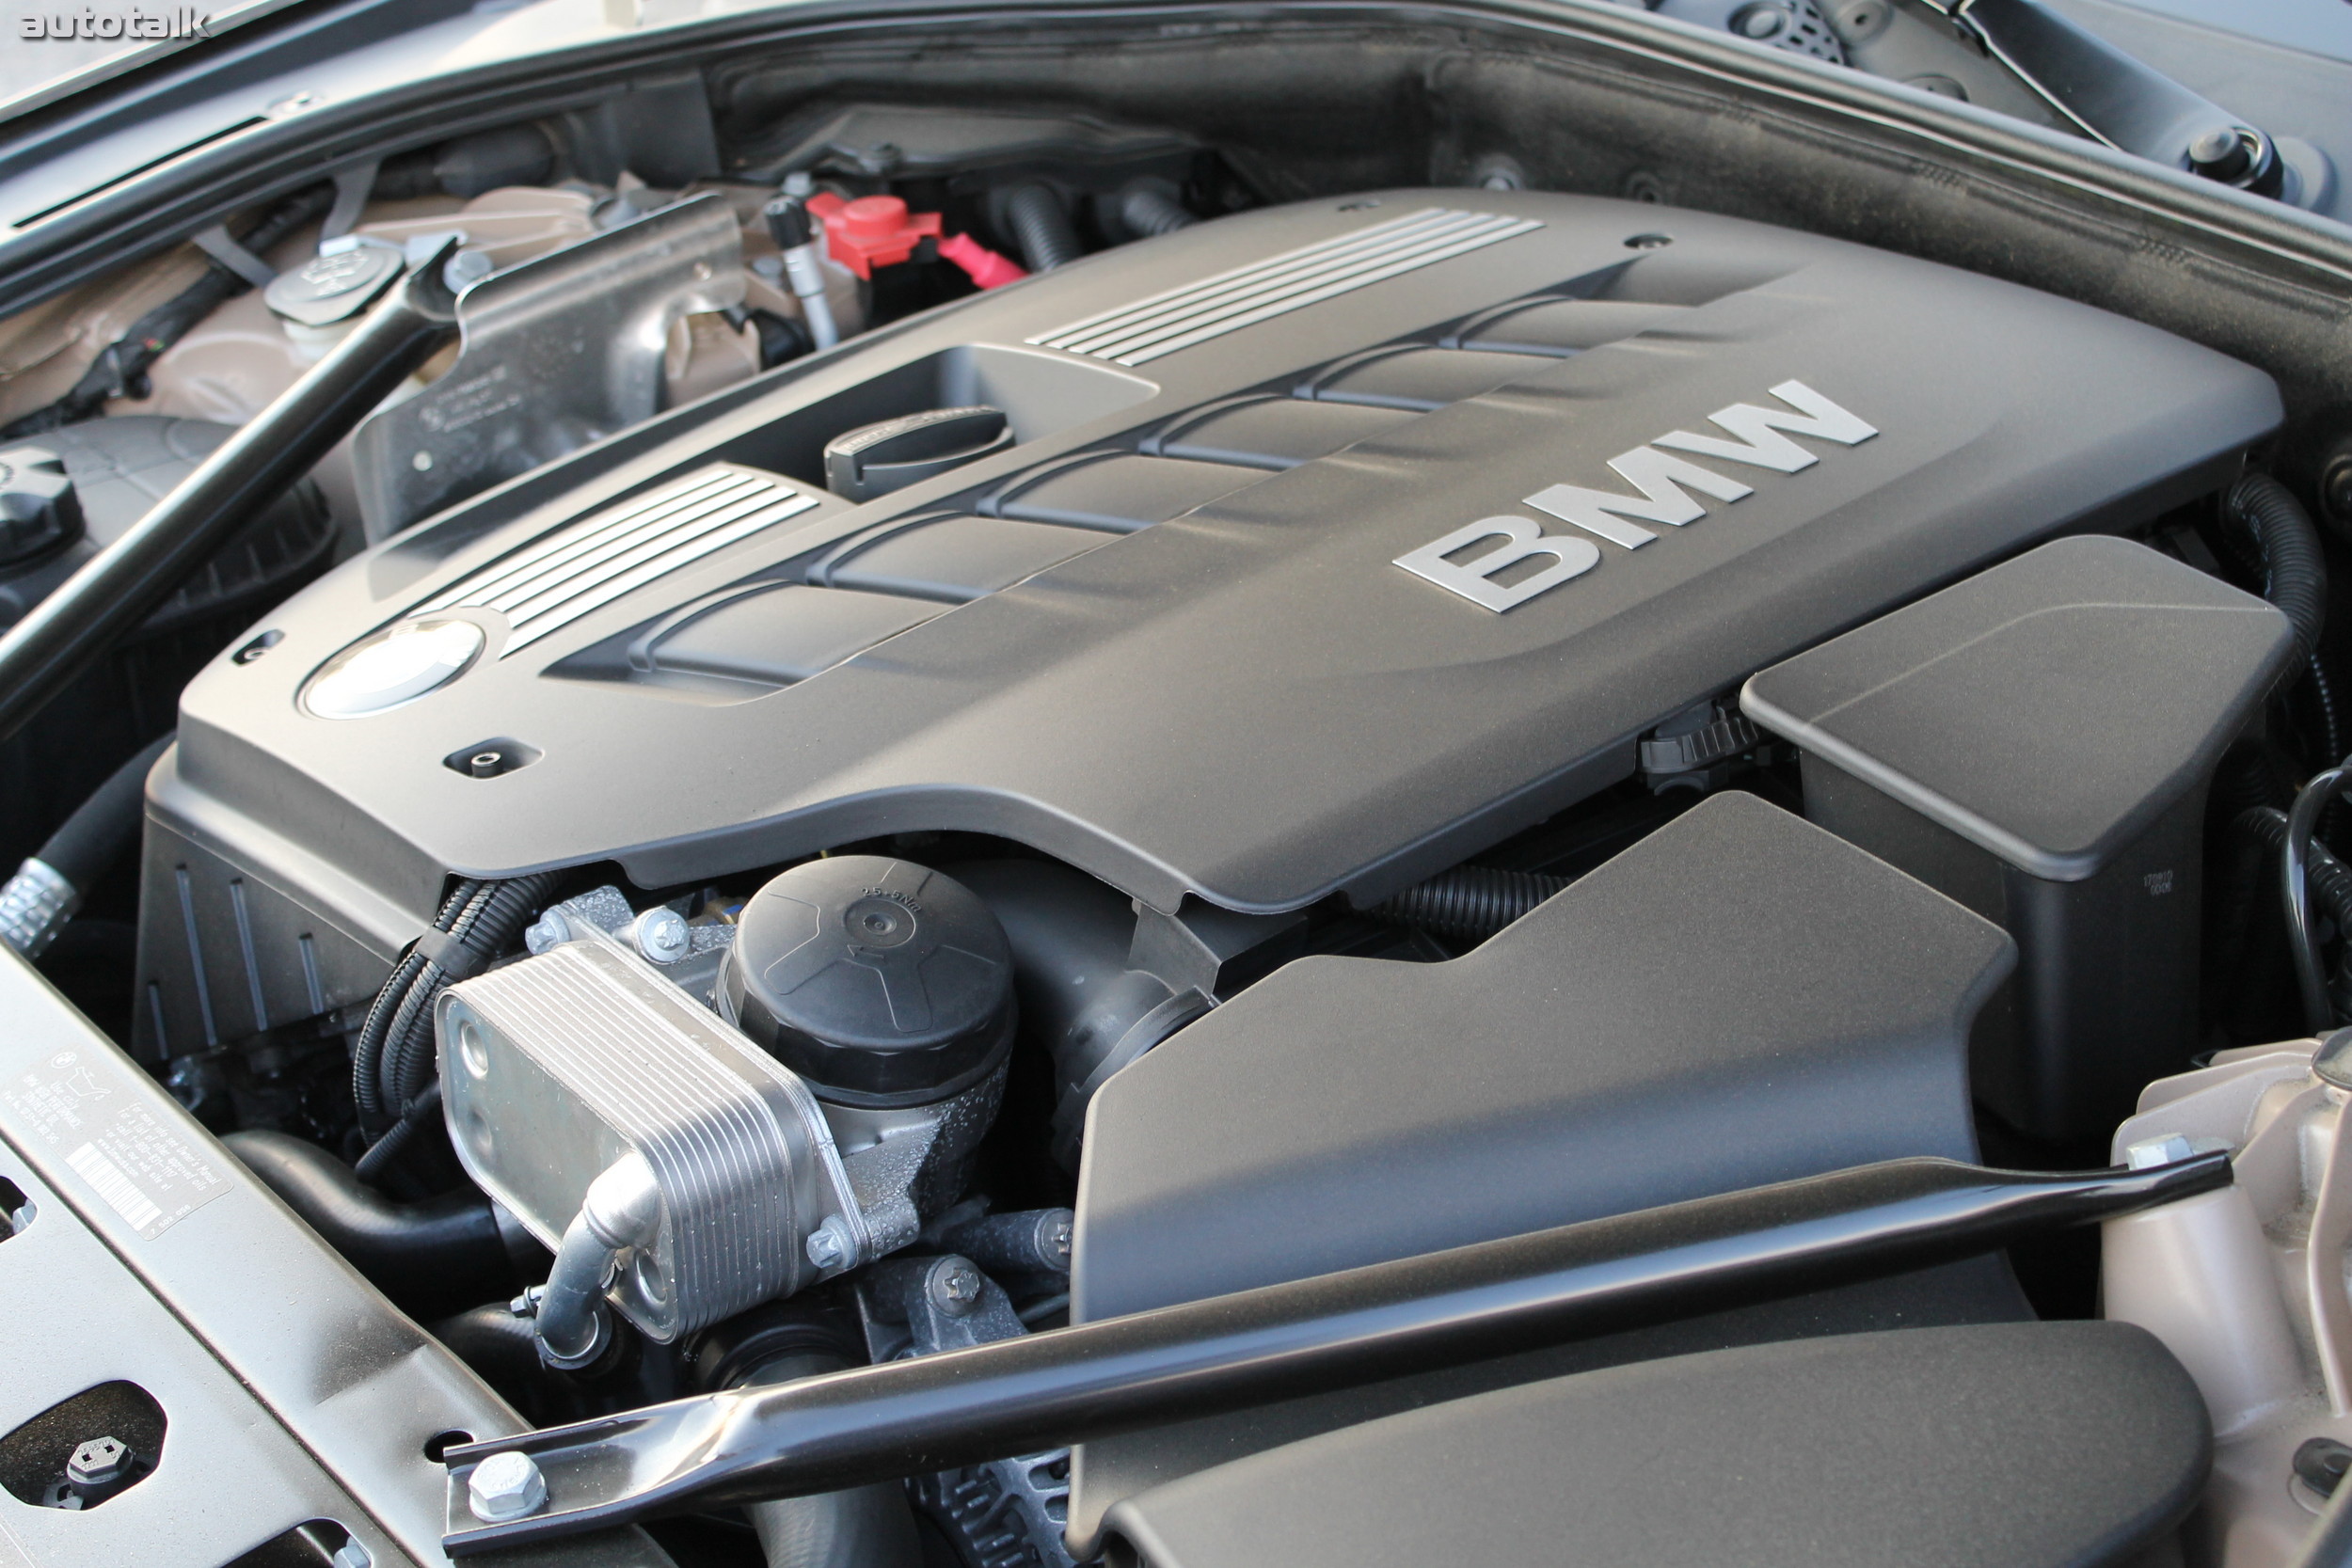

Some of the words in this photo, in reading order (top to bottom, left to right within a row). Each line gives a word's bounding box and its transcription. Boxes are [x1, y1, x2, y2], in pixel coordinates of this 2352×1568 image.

[1392, 379, 1879, 614] BMW
[50, 1081, 65, 1095] Use
[117, 1126, 132, 1136] call
[134, 1123, 150, 1135] list
[143, 1133, 158, 1143] of
[167, 1157, 198, 1180] approved
[192, 1180, 206, 1191] oils
[166, 1137, 179, 1148] see
[197, 1165, 221, 1184] Manual
